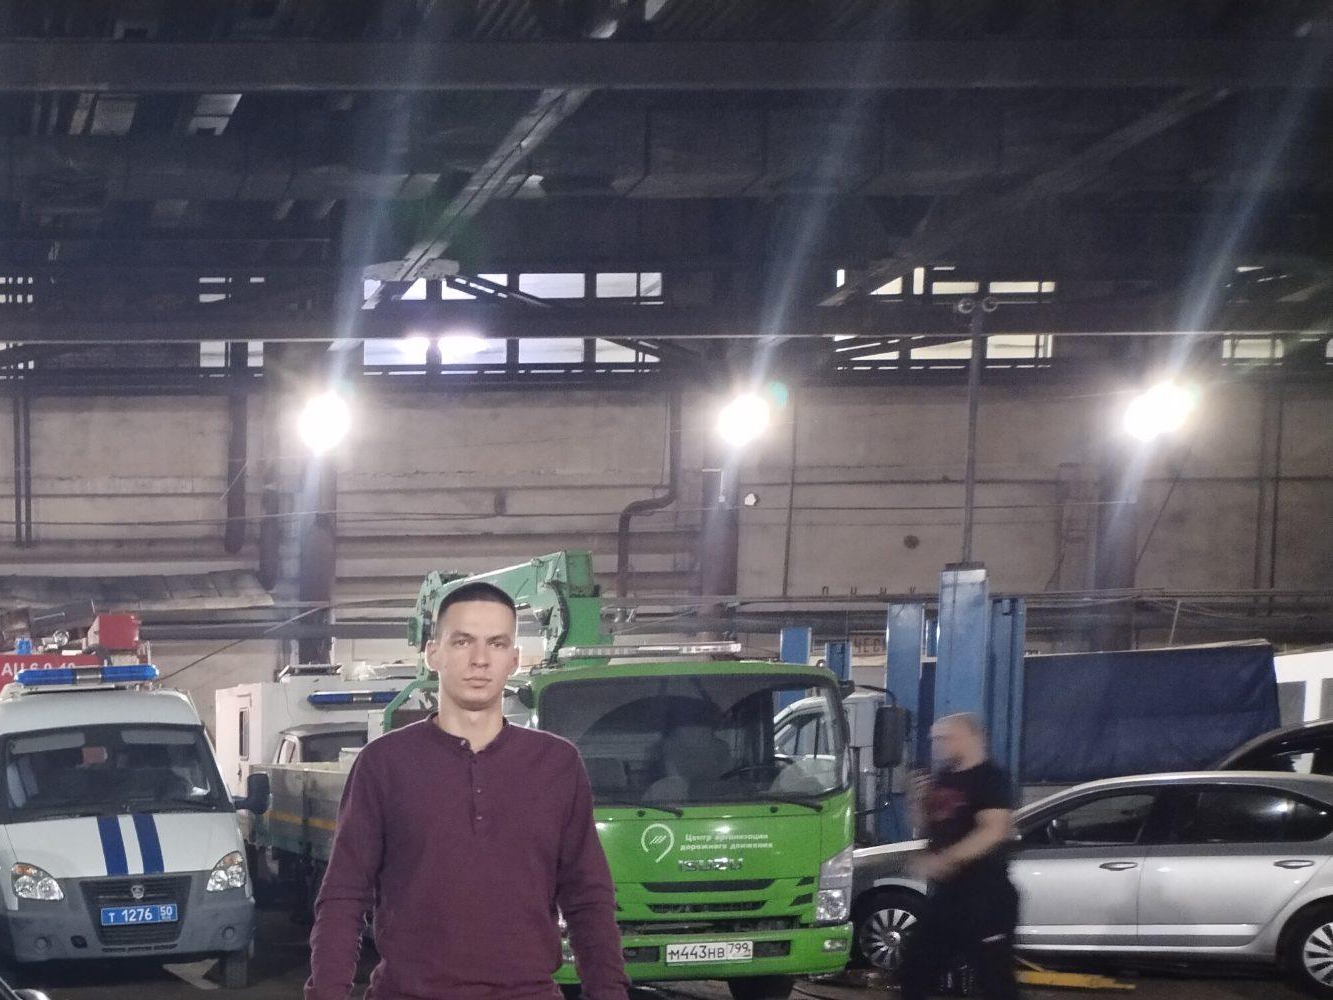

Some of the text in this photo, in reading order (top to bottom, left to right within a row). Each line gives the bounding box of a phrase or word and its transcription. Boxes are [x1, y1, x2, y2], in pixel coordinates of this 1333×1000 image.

[678, 857, 744, 871] ISUZU
[122, 908, 153, 922] 1276
[160, 906, 173, 916] 50
[728, 943, 749, 953] 799
